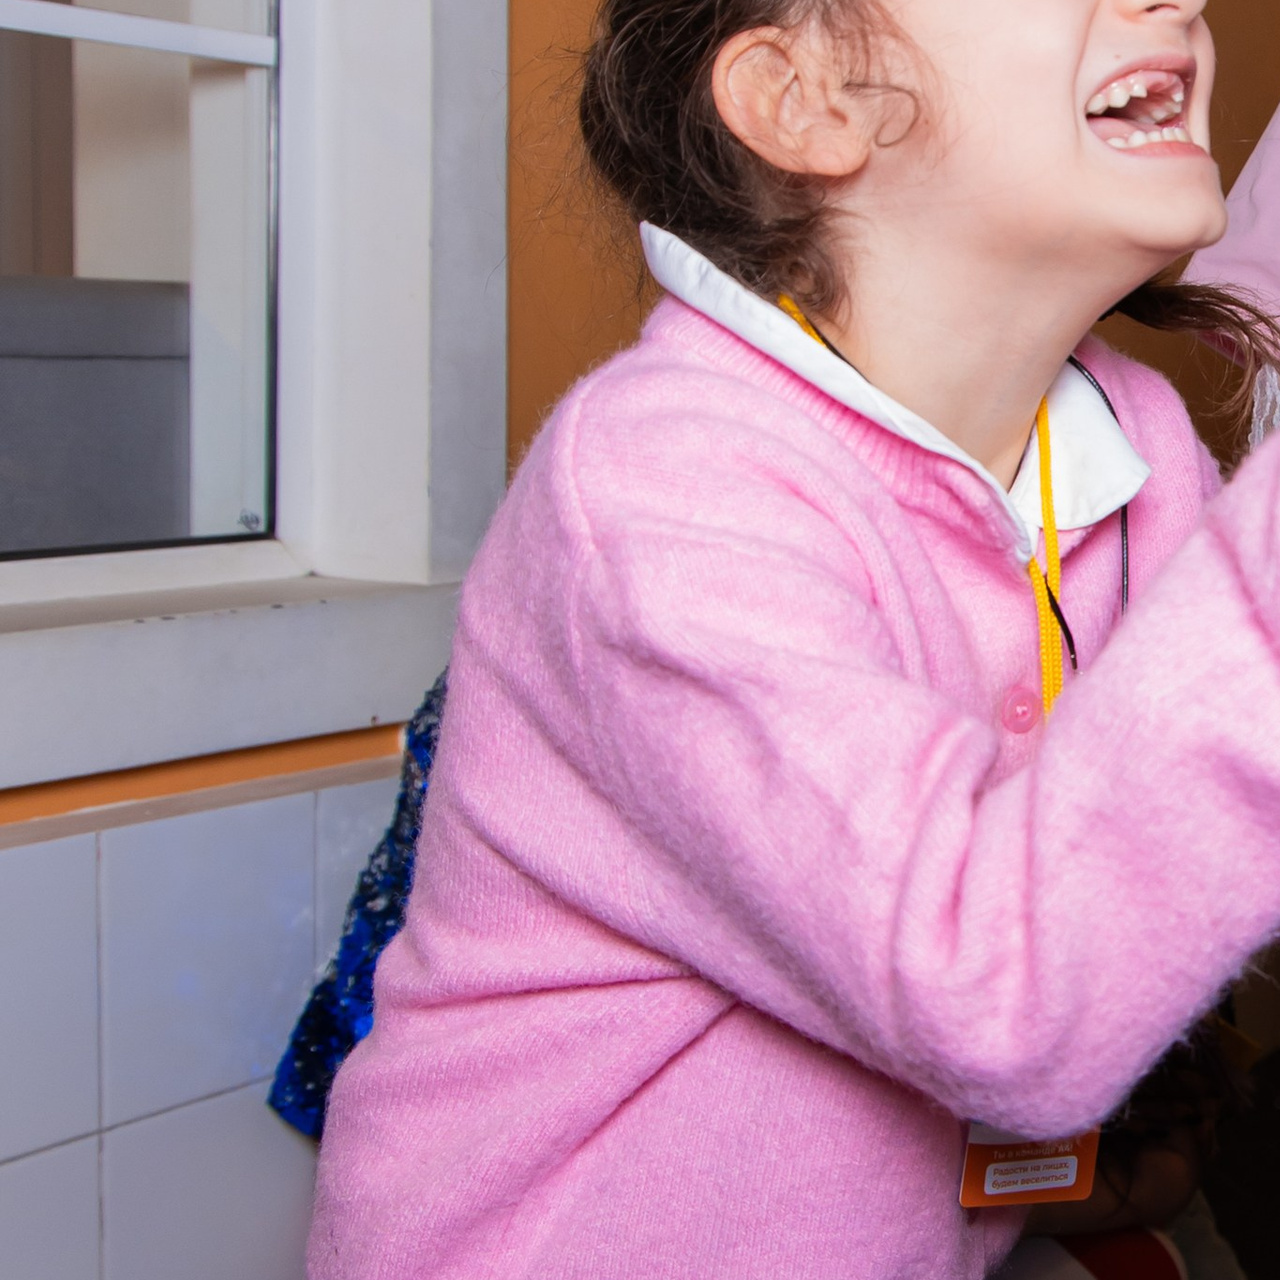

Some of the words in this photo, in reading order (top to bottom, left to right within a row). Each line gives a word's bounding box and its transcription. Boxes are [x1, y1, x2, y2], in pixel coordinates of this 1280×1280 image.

[993, 1166, 1029, 1176] Радости
[1030, 1164, 1042, 1172] на
[991, 1177, 1019, 1190] будем
[1020, 1173, 1069, 1185] веселиться
